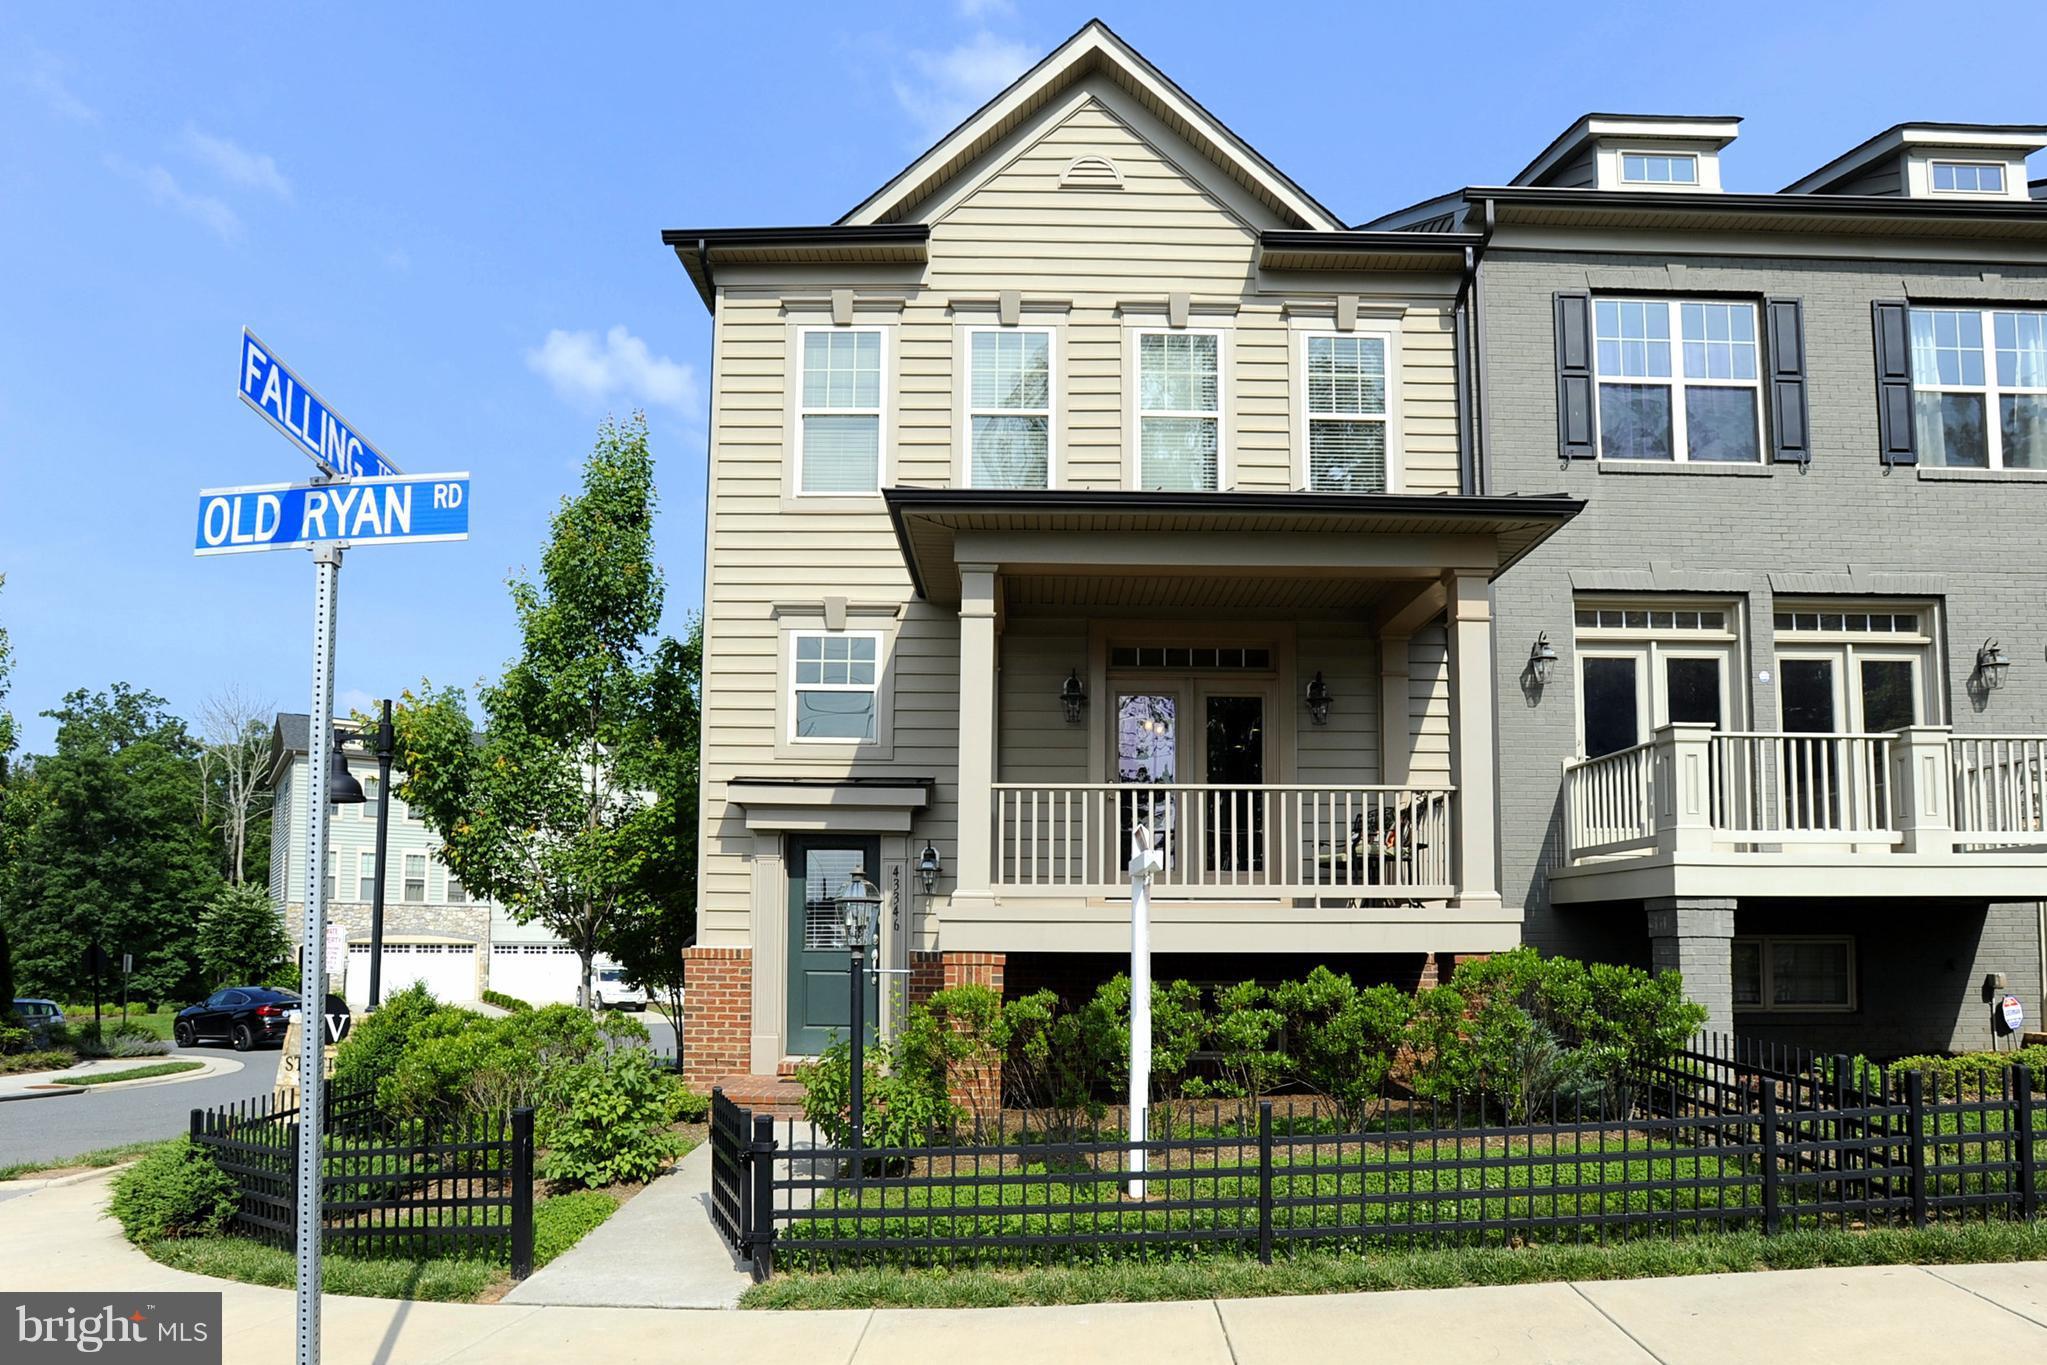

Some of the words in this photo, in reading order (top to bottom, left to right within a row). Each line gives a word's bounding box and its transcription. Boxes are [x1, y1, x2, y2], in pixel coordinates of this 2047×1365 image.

[244, 342, 364, 477] FALLING
[203, 494, 282, 547] OLD
[301, 485, 412, 539] RYAN
[433, 483, 463, 509] RD
[892, 864, 900, 932] 43346
